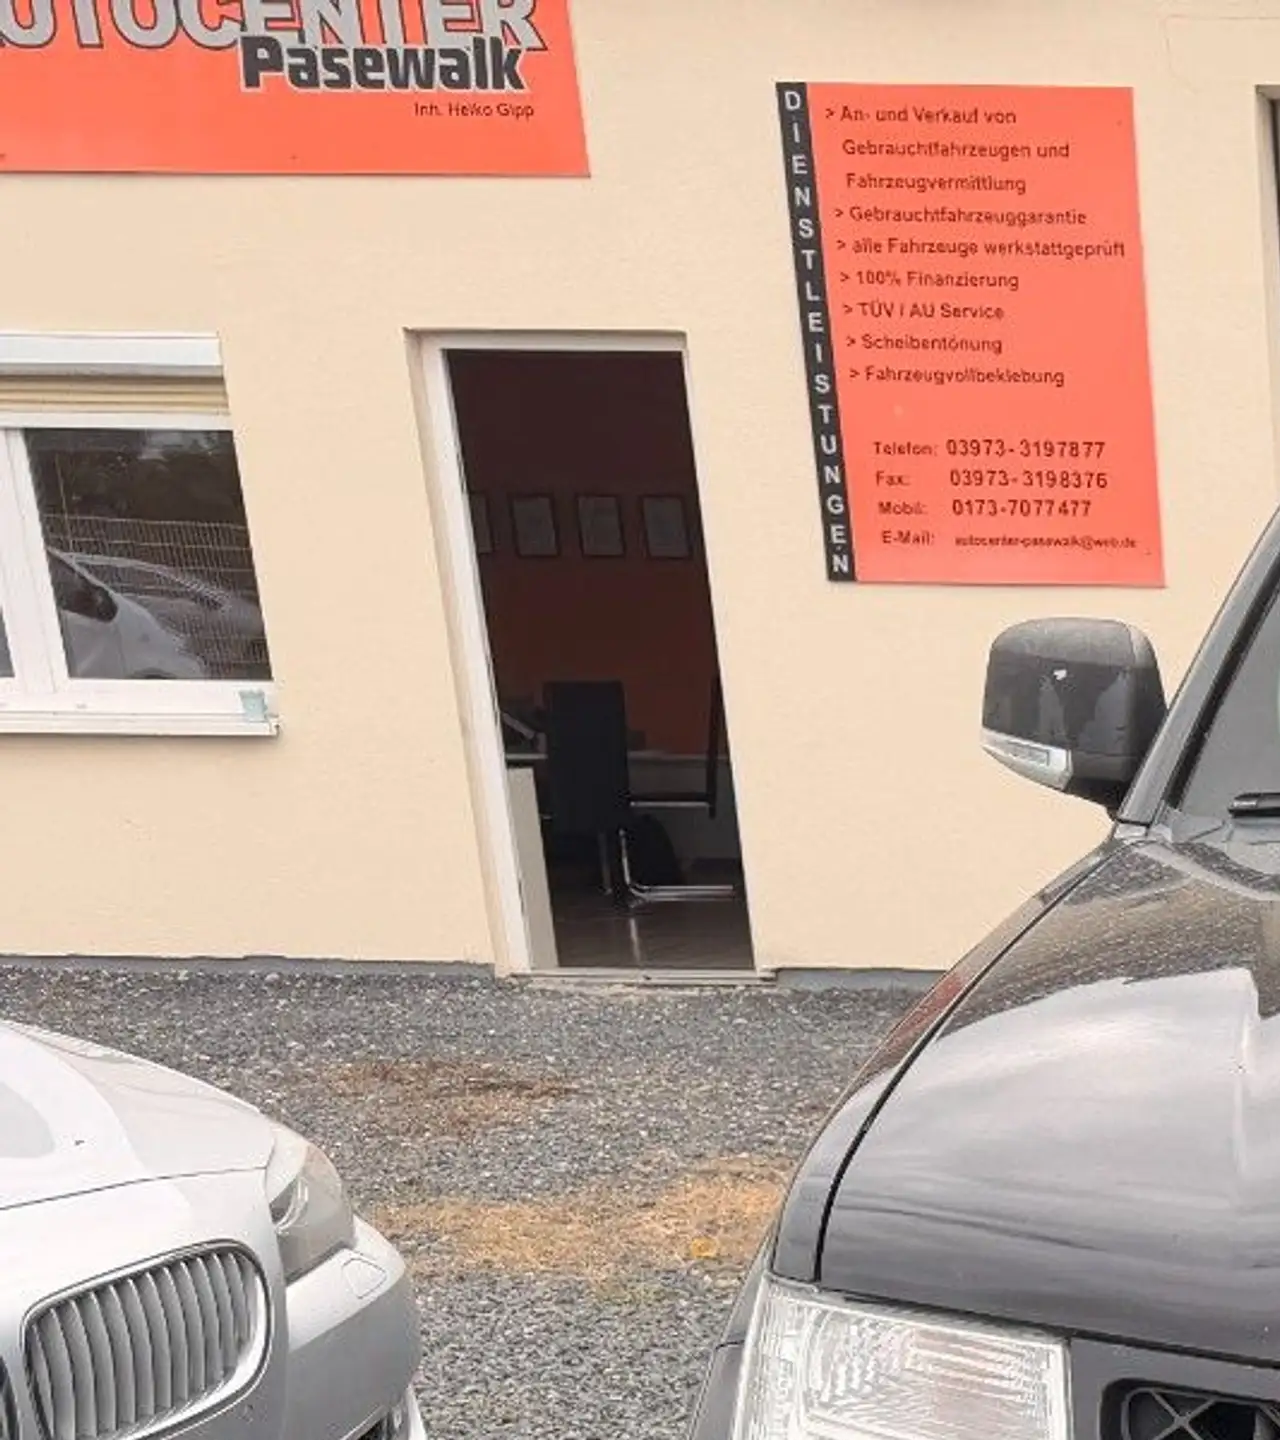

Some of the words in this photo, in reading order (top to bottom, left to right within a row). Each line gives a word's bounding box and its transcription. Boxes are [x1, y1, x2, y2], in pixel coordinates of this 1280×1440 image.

[0, 0, 549, 51] UTOCENTER
[239, 34, 528, 91] Pasewalk
[448, 102, 493, 118] Heiko
[496, 103, 535, 120] Gipp
[876, 106, 908, 122] und
[914, 107, 979, 124] Verkauf
[984, 111, 1016, 125] von
[842, 140, 1031, 161] Gebrauchtfahrzeugen
[1037, 143, 1070, 158] und
[846, 174, 1026, 195] Fahrzeugvermittlung
[849, 206, 1087, 226] Gebrauchtfahrzeuggarantie
[852, 240, 883, 255] alle
[888, 238, 979, 258] Fahrzeuge
[984, 242, 1125, 261] werkstattgeprüft
[856, 271, 902, 286] 100%
[907, 271, 1020, 291] Finanzierung
[858, 299, 895, 319] TÜV
[910, 304, 935, 319] AU
[941, 304, 1004, 320] Service
[862, 335, 1003, 355] Scheibentönung
[865, 367, 1065, 388] Fahrzeugvollbeklebung
[874, 441, 938, 457] Telefon:
[881, 530, 935, 546] E-Mail:
